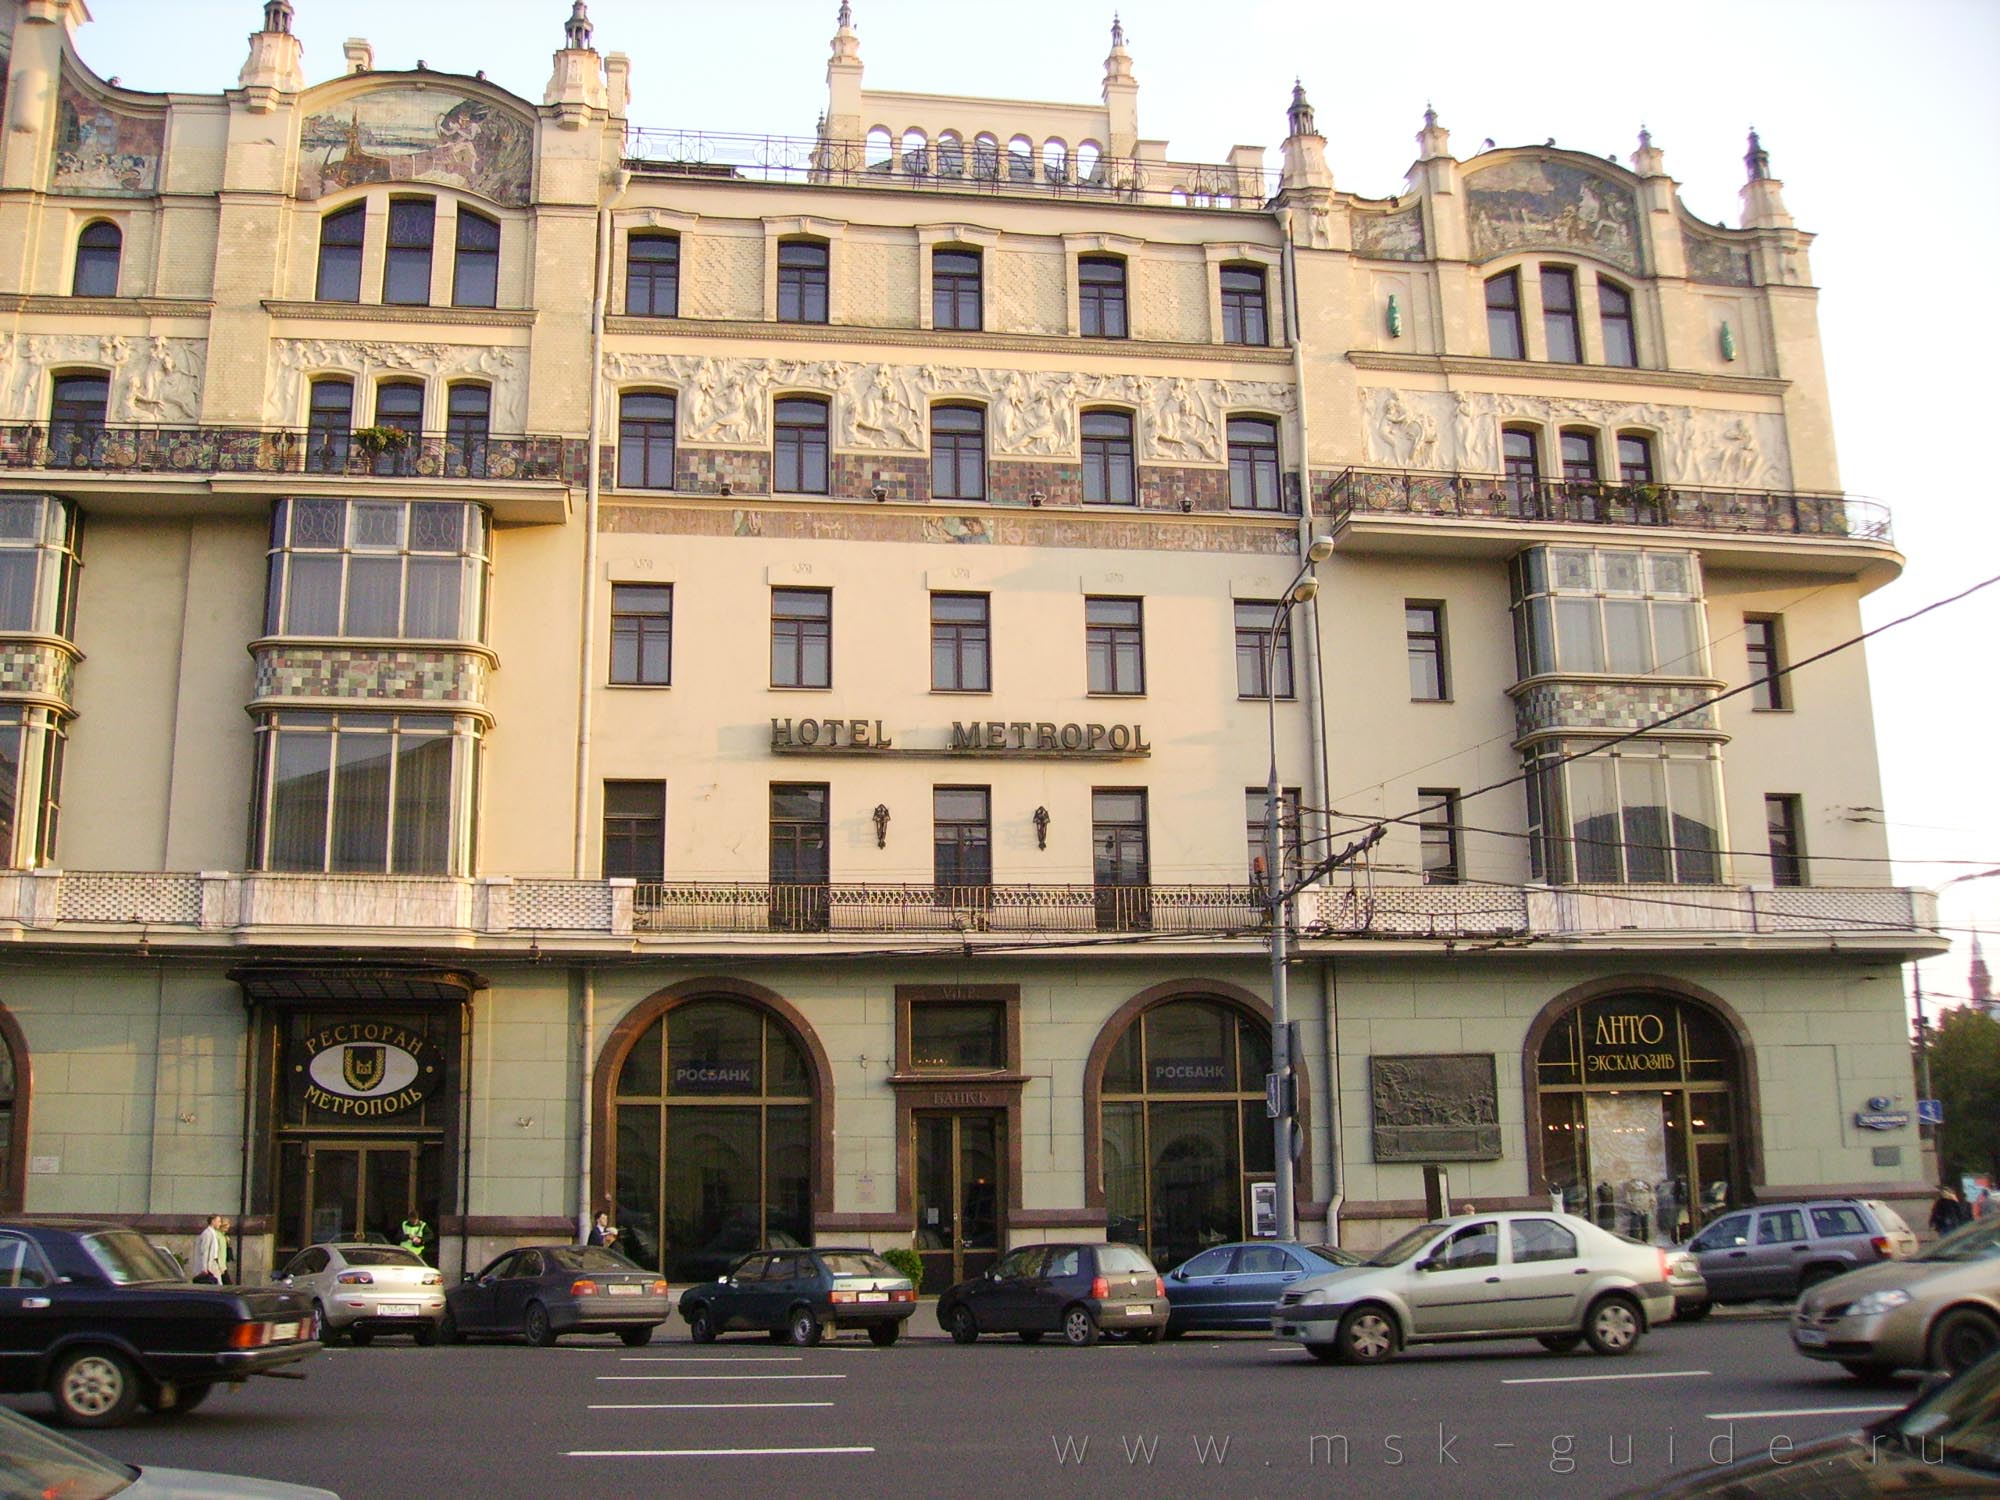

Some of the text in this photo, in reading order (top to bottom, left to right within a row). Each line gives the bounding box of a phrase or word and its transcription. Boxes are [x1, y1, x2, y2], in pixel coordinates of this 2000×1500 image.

[770, 718, 1152, 752] HOTEL METROPOL
[306, 1024, 424, 1055] РЕСТОРАН
[1595, 1014, 1664, 1045] АНТО
[676, 1068, 751, 1081] РОСБАНК
[1155, 1066, 1225, 1079] РОСБАНК
[1587, 1053, 1676, 1072] ЭКСКЛЮЗИВ
[304, 1085, 423, 1116] МЕТРОПОЛЬ
